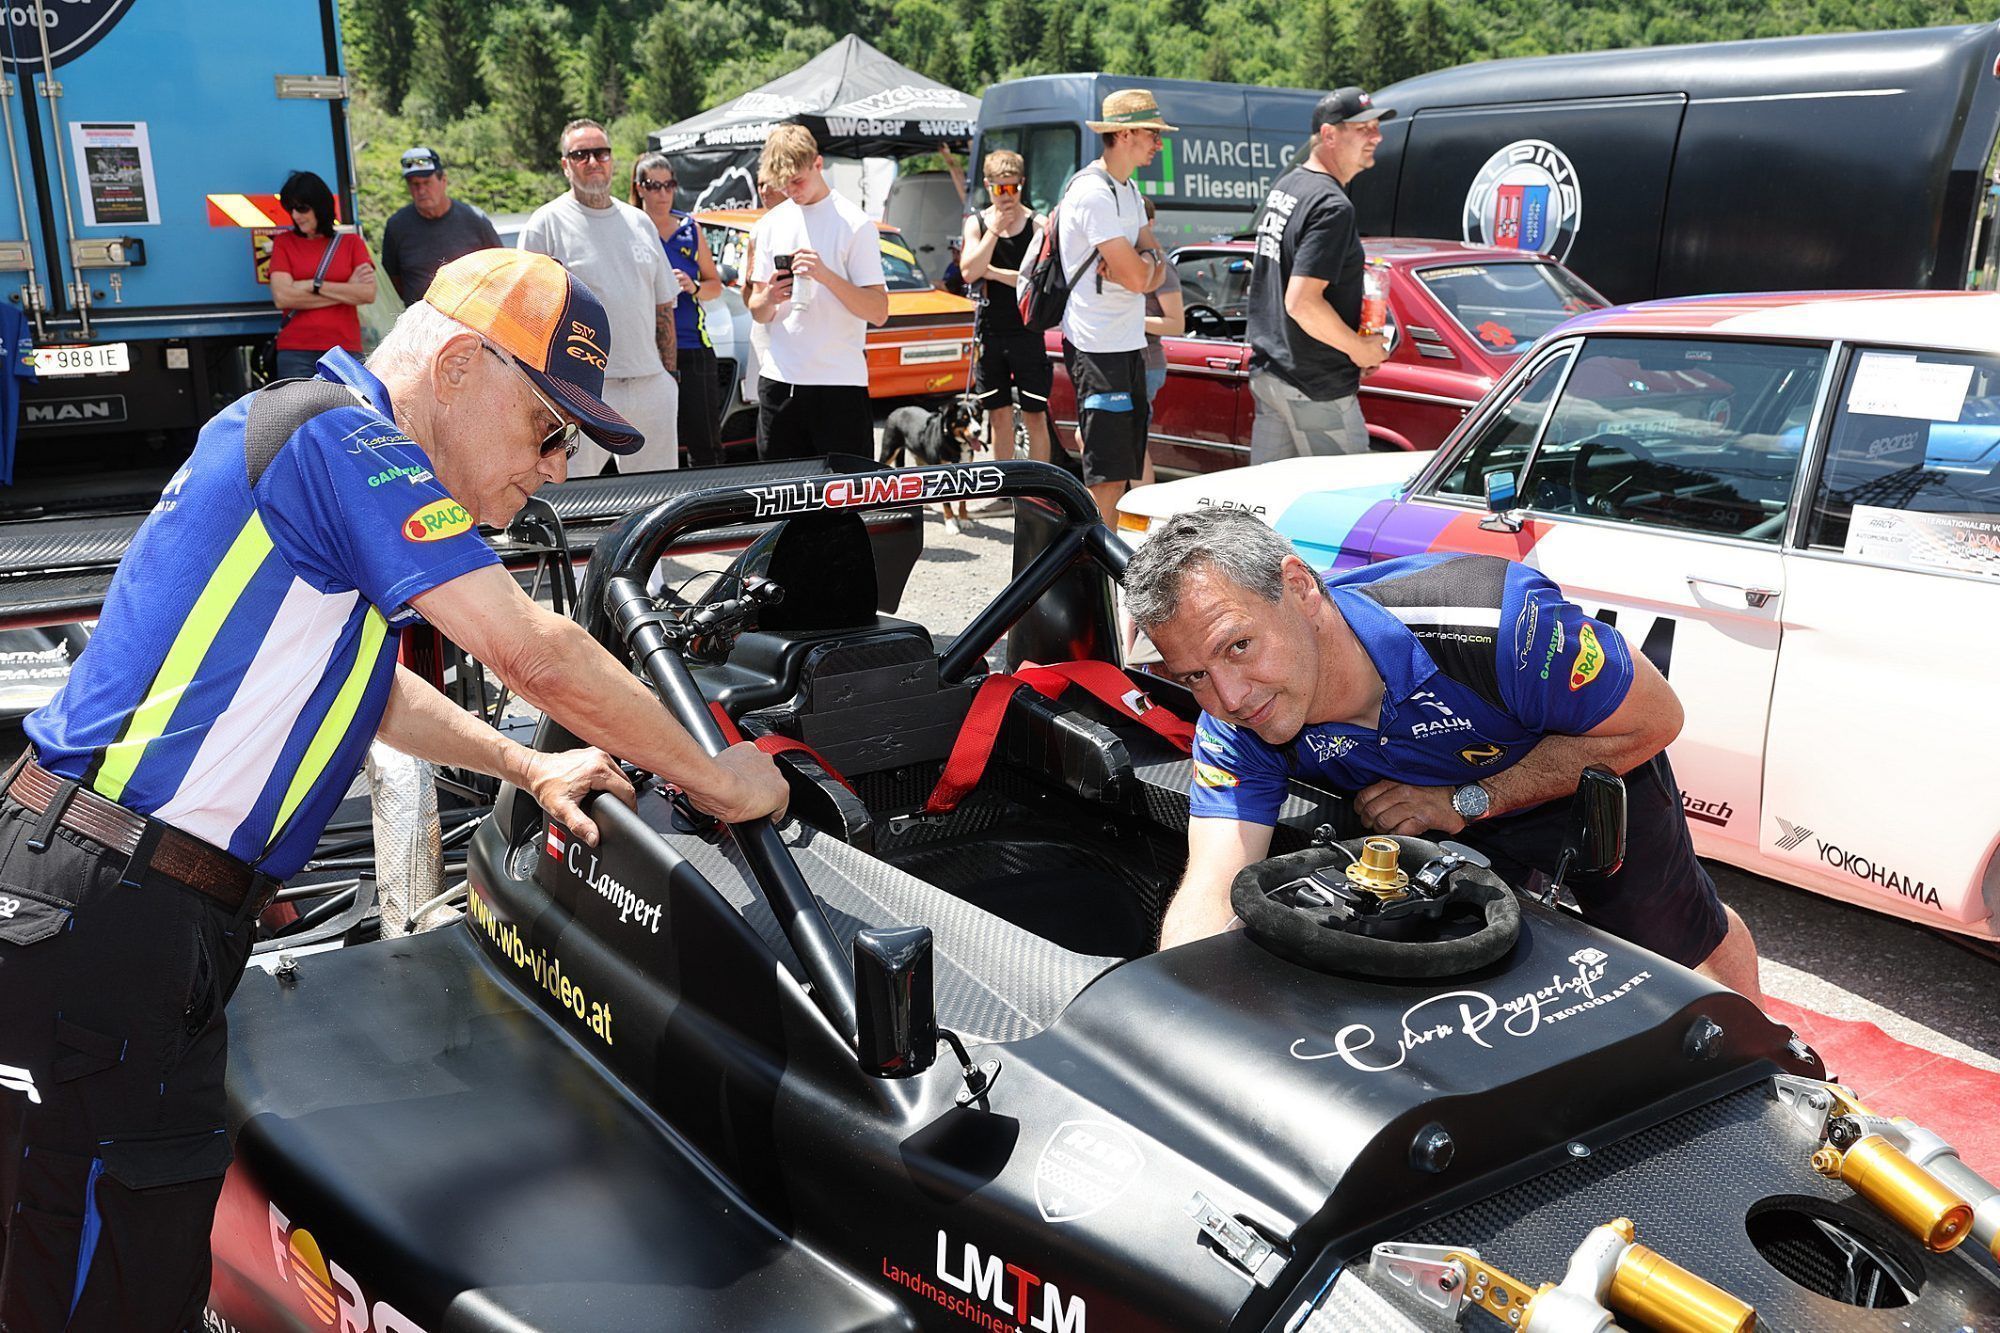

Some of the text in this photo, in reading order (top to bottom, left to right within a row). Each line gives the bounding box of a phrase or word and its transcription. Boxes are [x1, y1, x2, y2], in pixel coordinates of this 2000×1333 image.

[834, 117, 906, 136] Weber
[1182, 138, 1300, 169] MARCEL G
[1469, 145, 1577, 222] ALPINA
[57, 351, 94, 368] 988
[26, 402, 110, 422] MAN
[1576, 626, 1598, 676] RAUCH
[568, 842, 663, 934] C. Lampert
[1816, 838, 1943, 911] YOKOHAMA
[469, 882, 614, 1046] www.wb-video.at
[1542, 971, 1653, 1026] PHOTOGRAPHY
